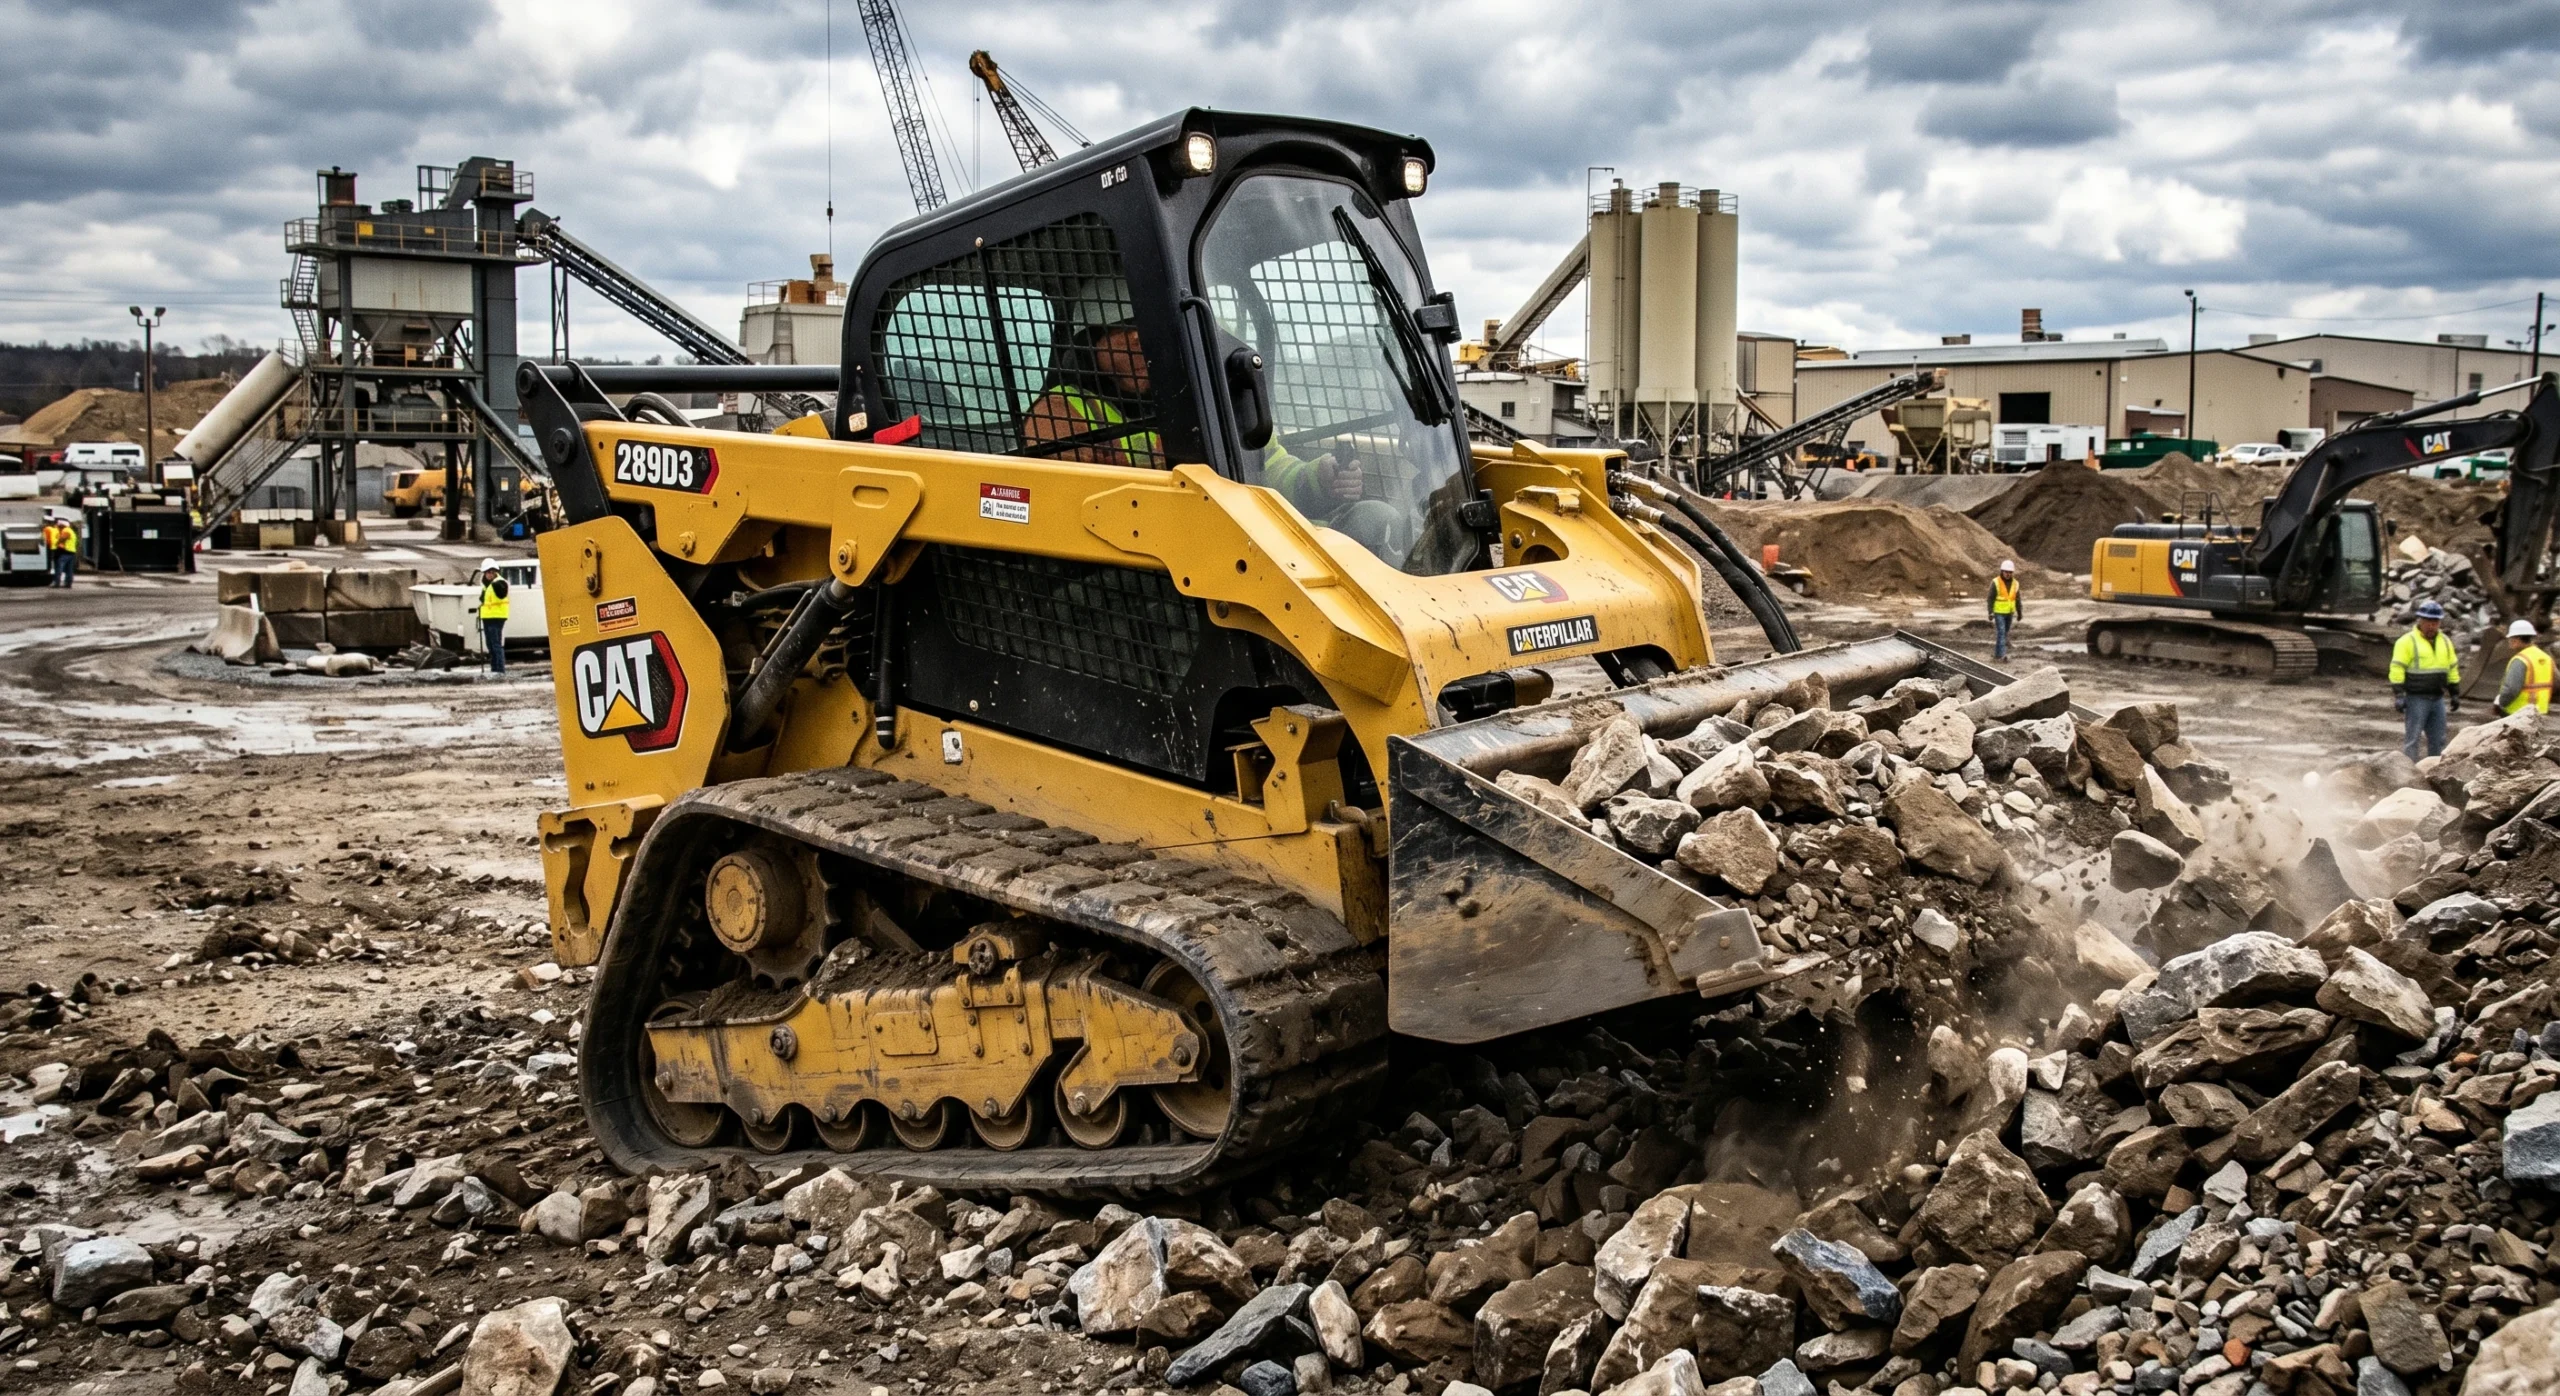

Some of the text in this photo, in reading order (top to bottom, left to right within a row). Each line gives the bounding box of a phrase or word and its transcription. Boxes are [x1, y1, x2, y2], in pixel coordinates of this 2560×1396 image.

[2422, 431, 2452, 455] CAT
[617, 443, 694, 488] 289D3
[2173, 548, 2199, 569] CAT
[1491, 573, 1550, 601] CAT
[1513, 618, 1594, 652] CATERPILLAR
[574, 638, 655, 733] CAT
